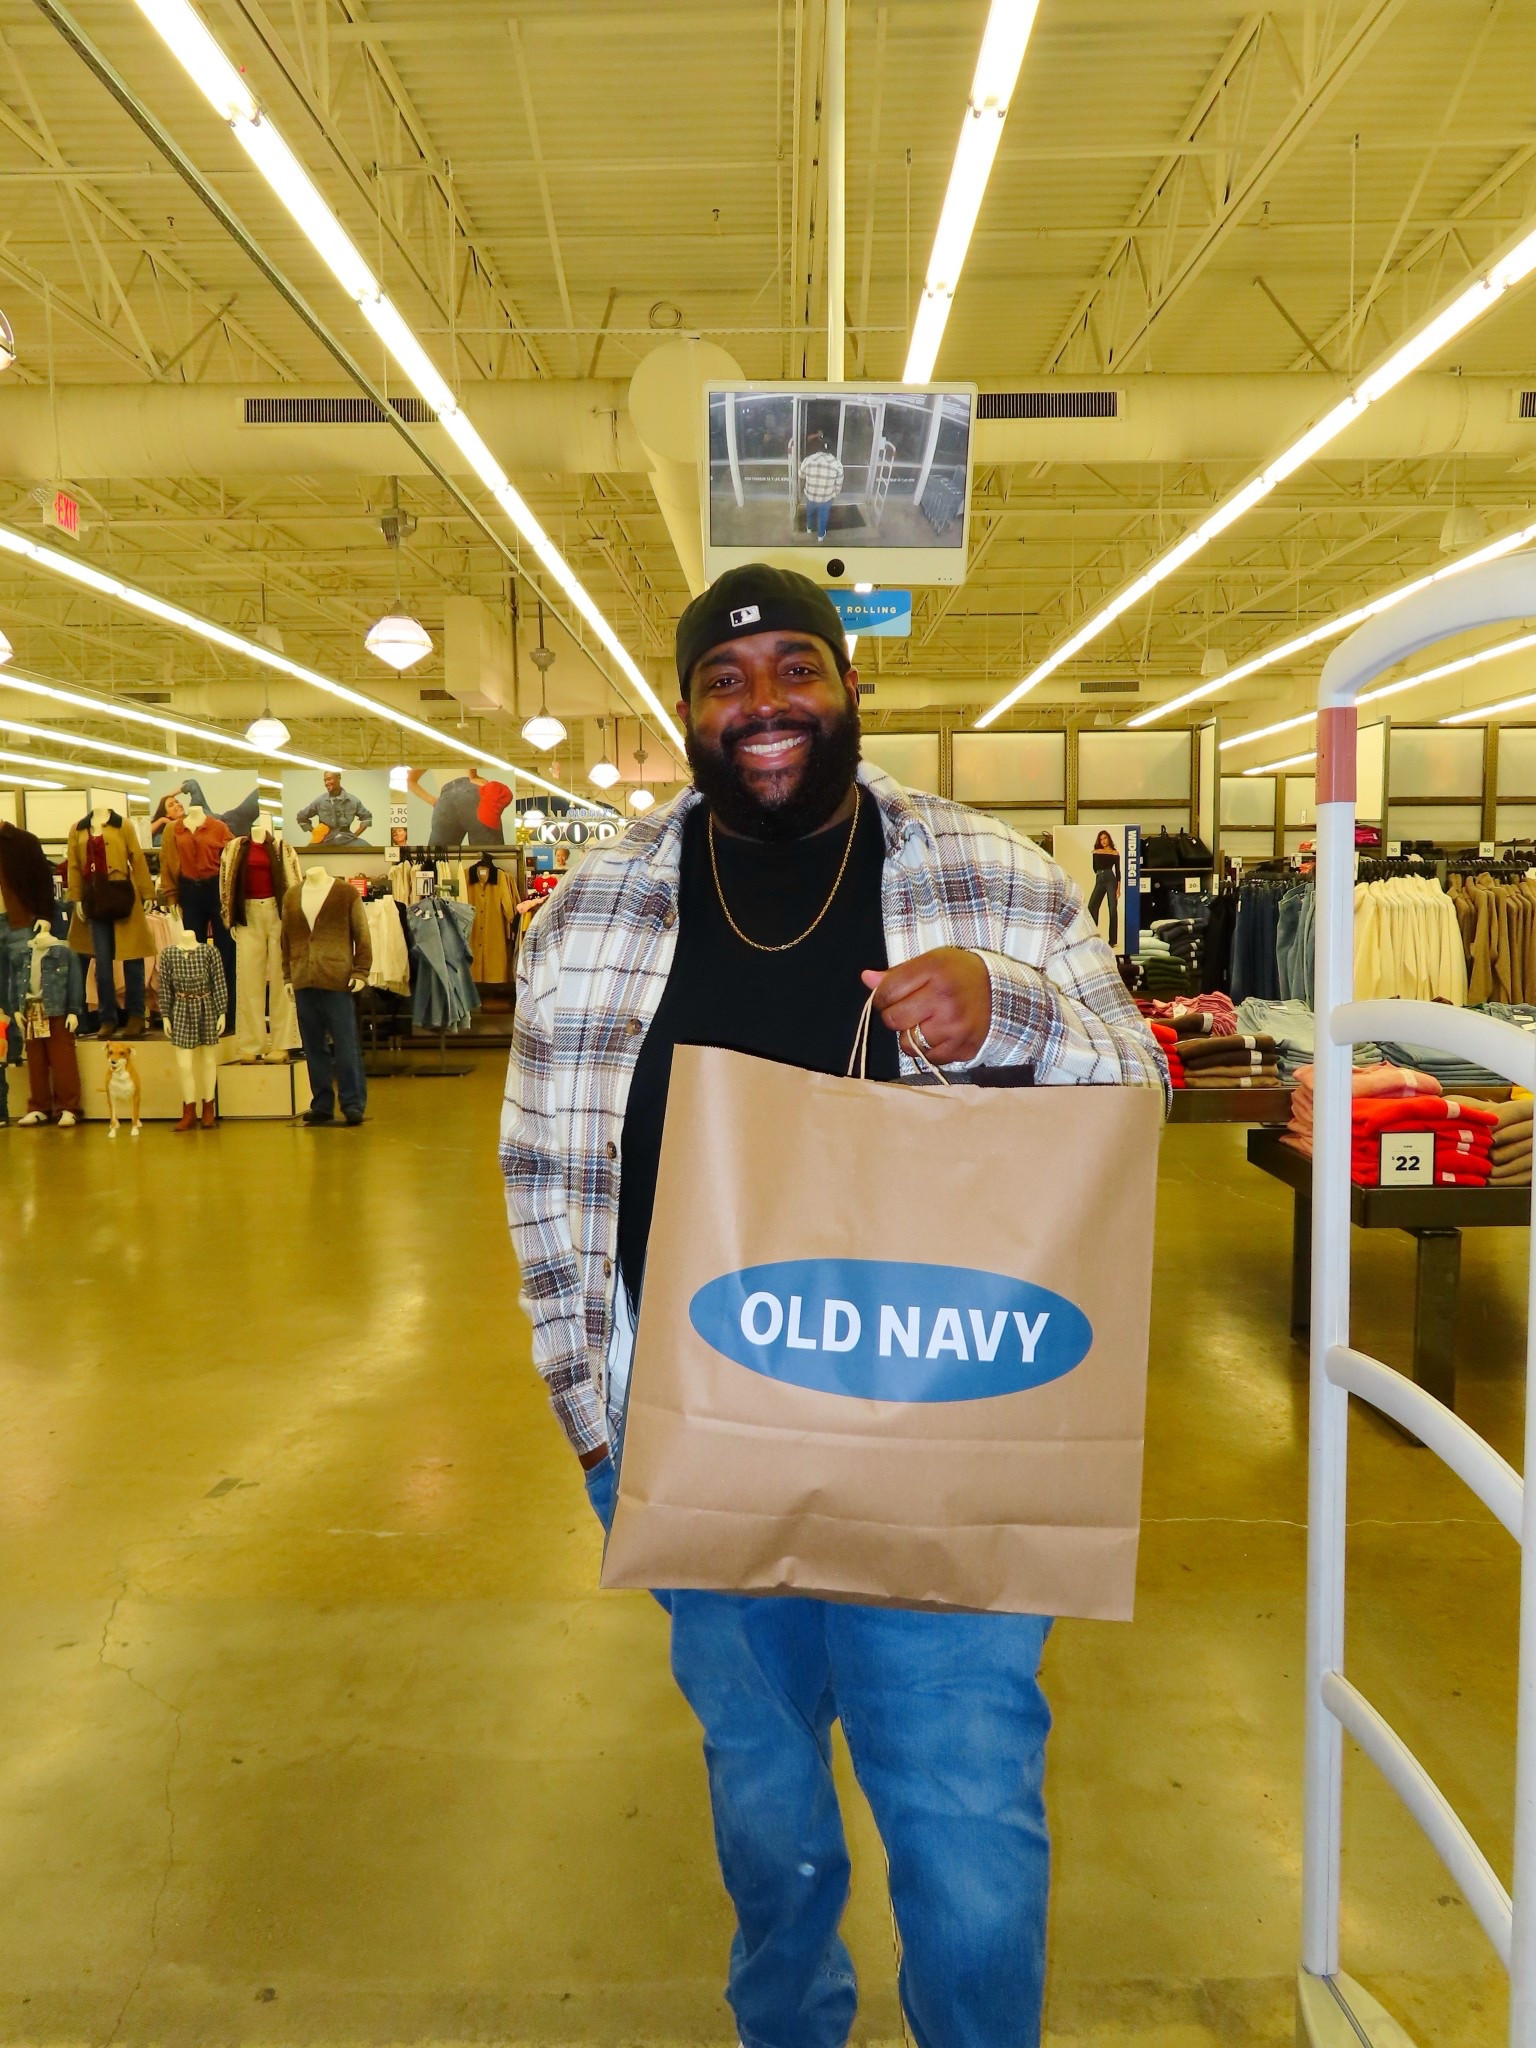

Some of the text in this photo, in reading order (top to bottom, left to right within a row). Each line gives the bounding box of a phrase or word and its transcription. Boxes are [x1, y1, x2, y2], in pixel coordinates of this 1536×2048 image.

[57, 492, 78, 533] EXIT
[847, 606, 897, 614] ROLLING
[390, 816, 407, 824] OO
[541, 824, 636, 842] KID
[1127, 830, 1137, 857] WIDE
[1127, 858, 1137, 878] LEG
[740, 1291, 1051, 1364] OLD NAVY
